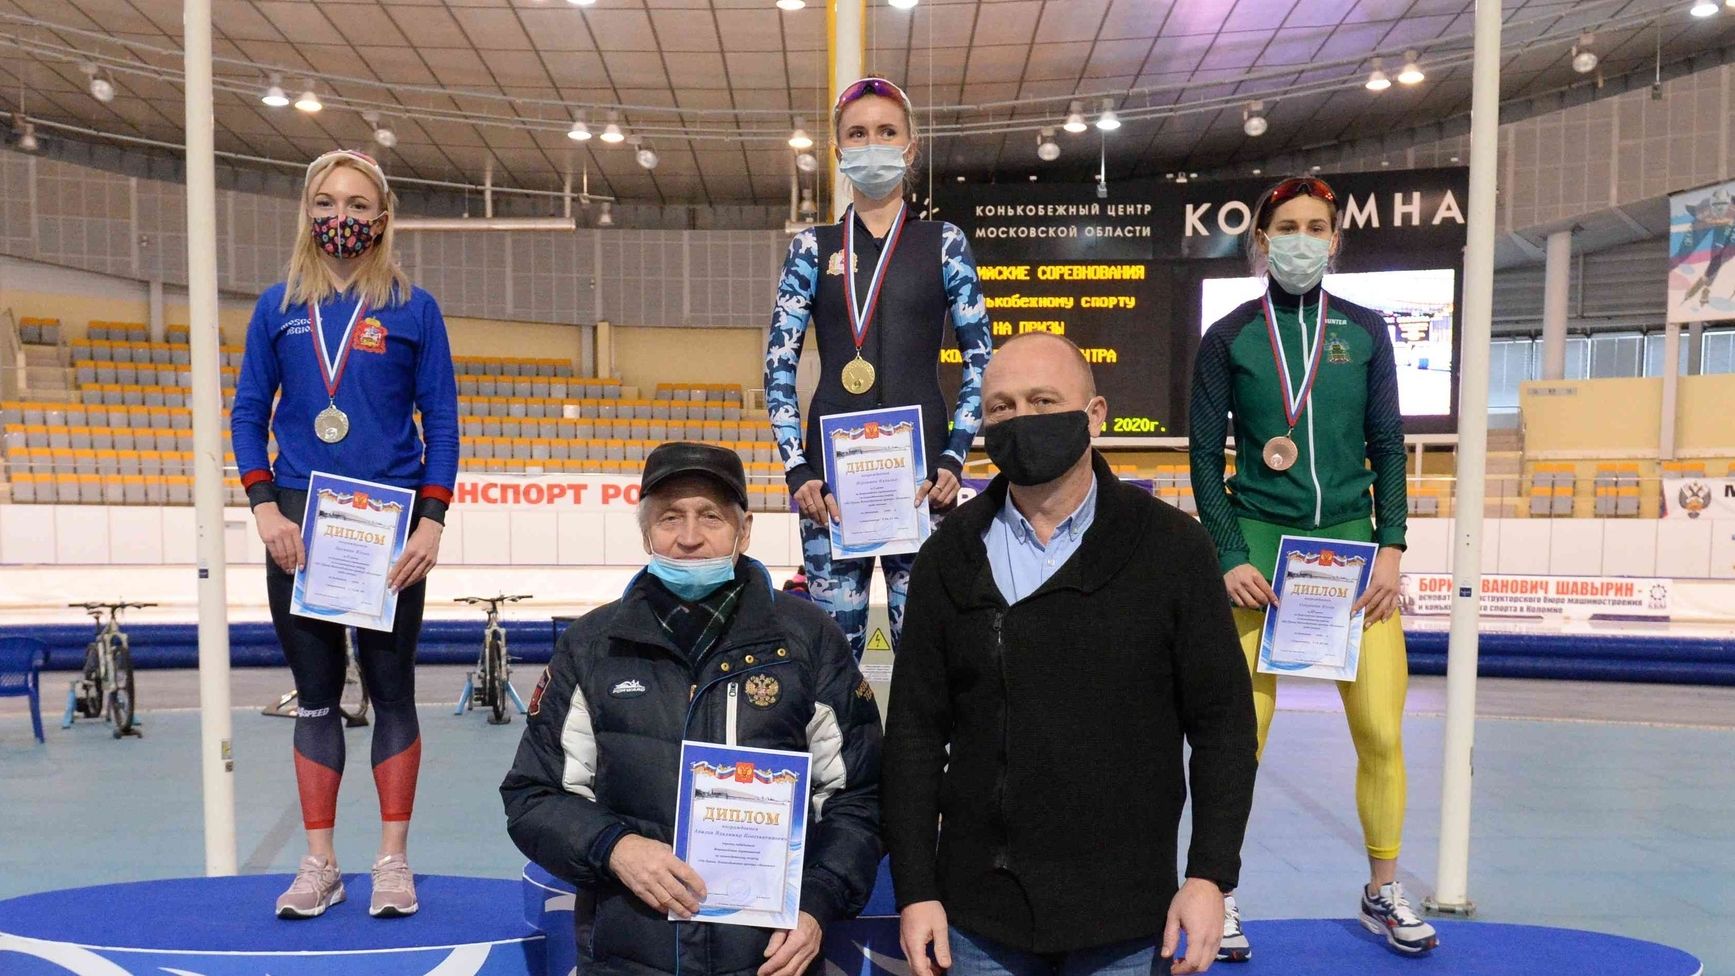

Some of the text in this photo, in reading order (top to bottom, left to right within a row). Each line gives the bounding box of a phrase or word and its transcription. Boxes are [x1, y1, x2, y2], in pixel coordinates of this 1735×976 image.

[975, 203, 1152, 217] КОНЬКОБЕЖНЫЙ ЦЕНТР
[1184, 189, 1466, 237] КОМНА
[975, 225, 1151, 238] МОСКОВСКОЙ ОБЛАСТИ
[1037, 265, 1145, 280] СОРЕВНОВАНИЯ
[985, 294, 1136, 309] ькобежному спорту
[992, 321, 1065, 336] НА ПРИЗЫ
[1079, 348, 1117, 363] НТРА
[1113, 417, 1166, 432] 2020г.
[845, 457, 905, 475] ДИПЛОМ
[451, 482, 587, 505] НСПОРТ
[323, 525, 386, 546] ДИПЛОМ
[1291, 584, 1349, 599] ДИПЛОМ
[1481, 579, 1549, 595] ВАНОВИЧ
[1555, 580, 1634, 597] ШАВЫРИН
[1418, 594, 1450, 602] основат
[702, 806, 780, 826] ДИПЛОМ
